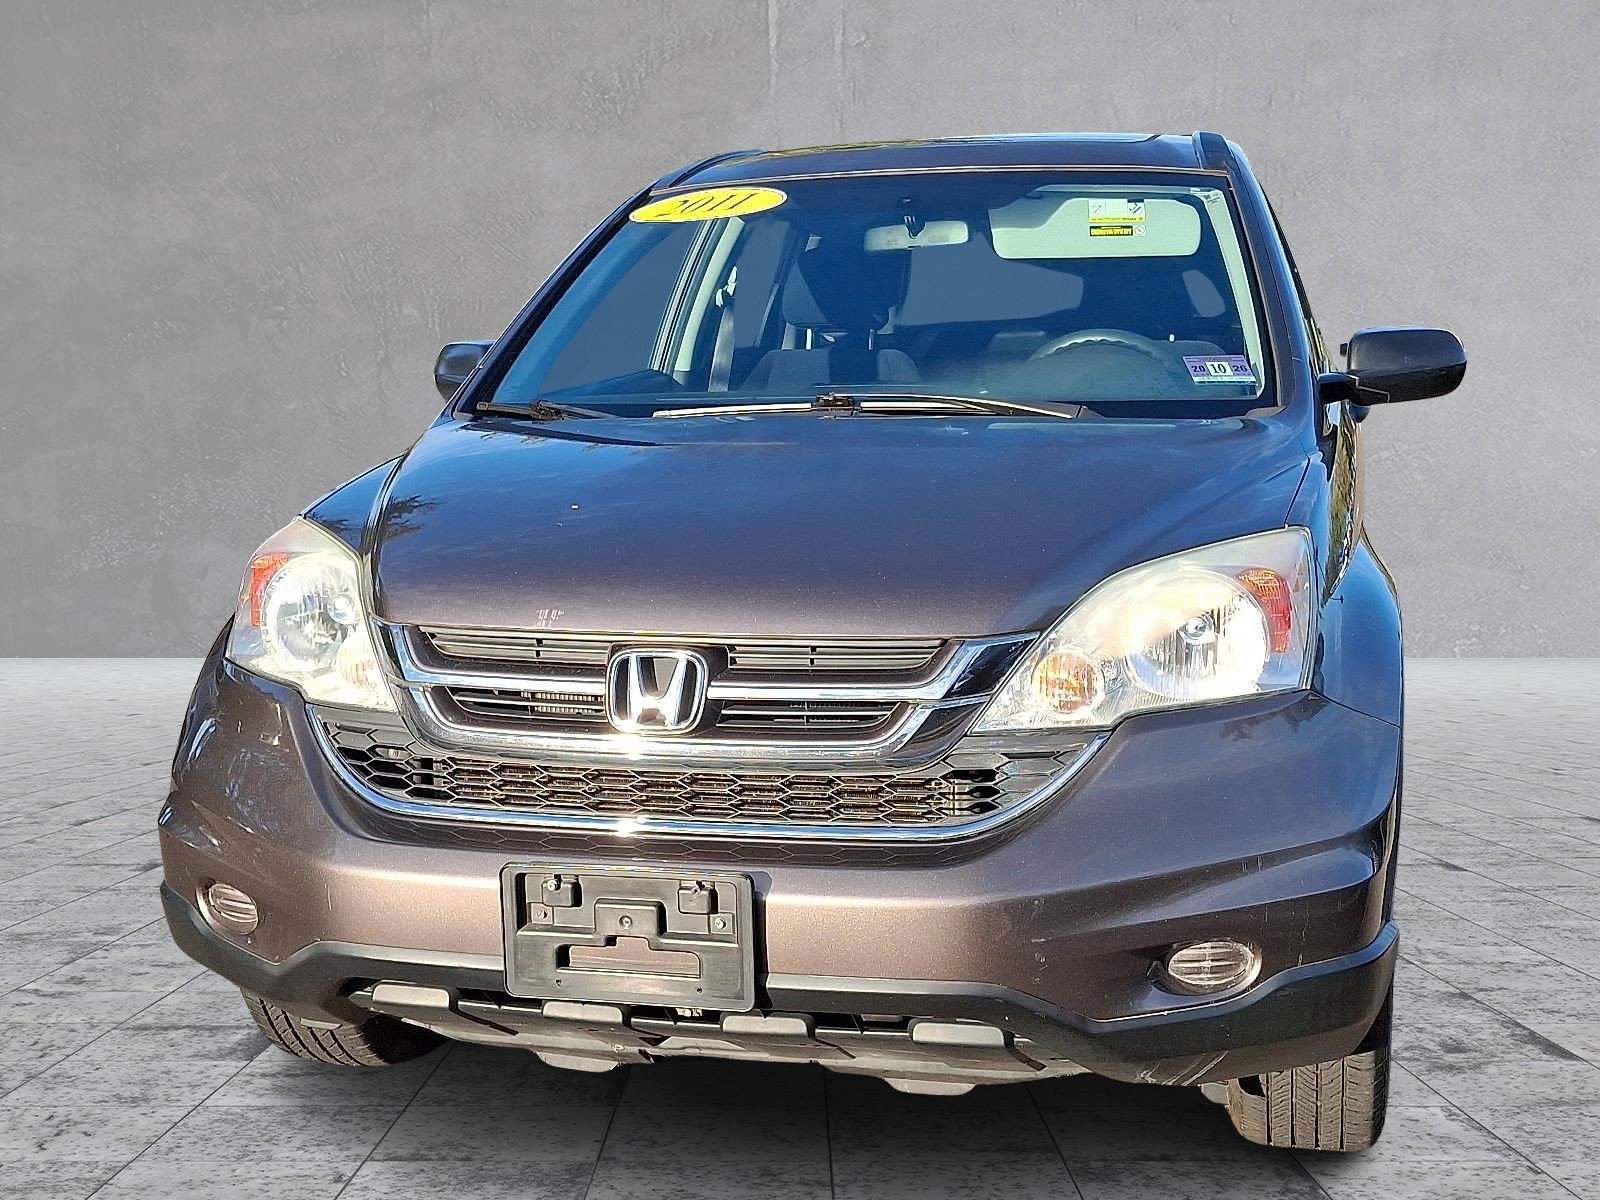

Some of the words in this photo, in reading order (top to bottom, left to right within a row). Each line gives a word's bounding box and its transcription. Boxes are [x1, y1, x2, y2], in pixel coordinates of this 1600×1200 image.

[653, 192, 758, 218] 2011
[1191, 365, 1206, 373] 20
[1210, 363, 1227, 374] 10
